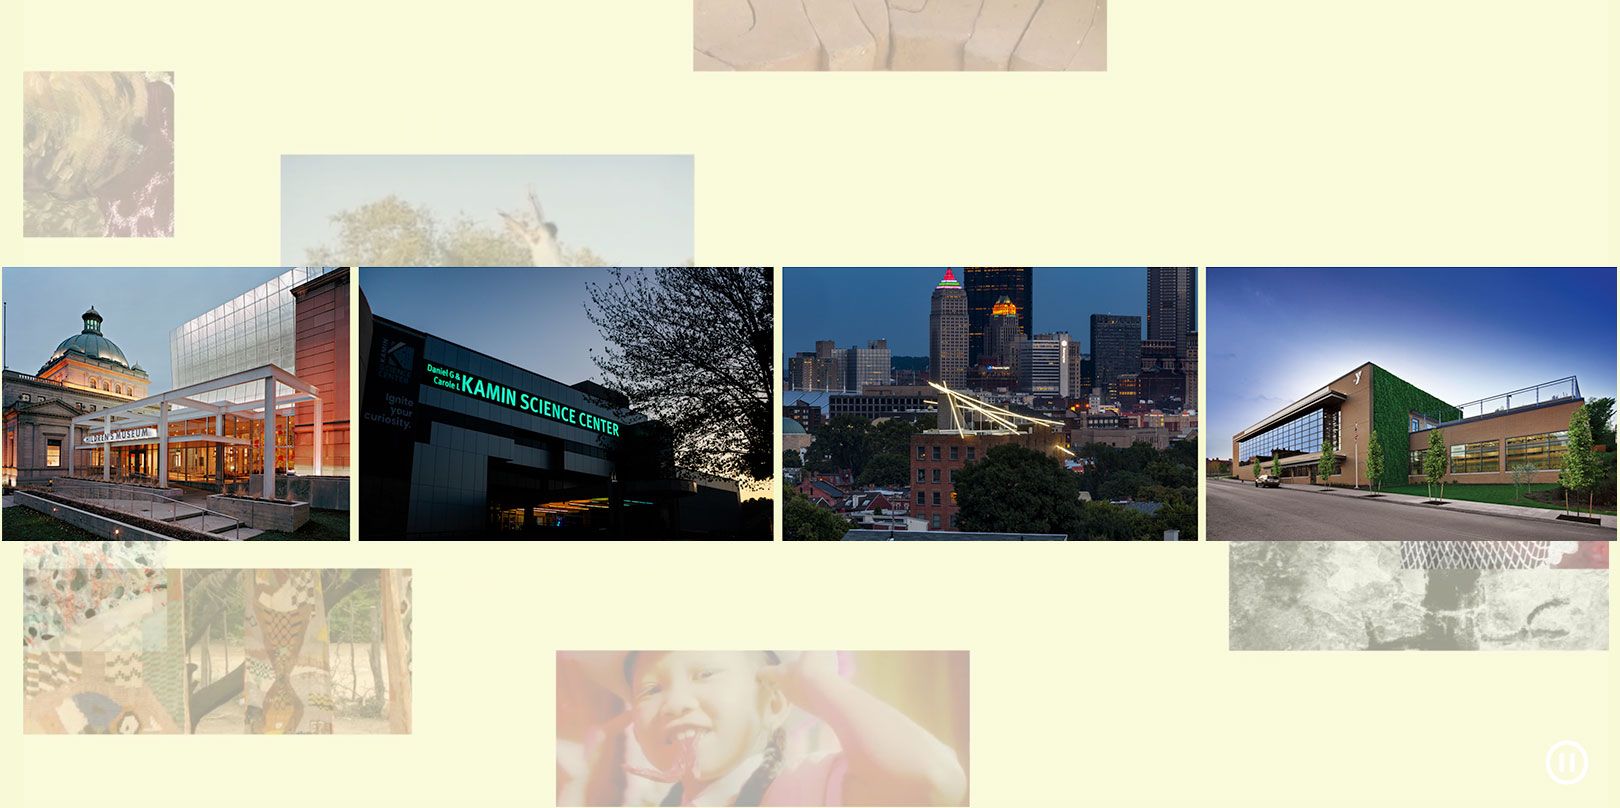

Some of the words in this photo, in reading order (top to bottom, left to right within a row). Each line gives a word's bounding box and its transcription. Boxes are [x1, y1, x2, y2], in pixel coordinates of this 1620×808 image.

[427, 363, 449, 378] Daniel
[449, 370, 455, 379] G
[455, 373, 461, 381] &
[433, 376, 455, 390] Carole
[456, 383, 461, 391] L
[386, 393, 414, 406] Ignite
[461, 374, 517, 407] KAMIN
[520, 393, 577, 424] SCIENCE
[579, 412, 620, 437] CENTER
[390, 406, 413, 418] your
[363, 411, 412, 430] curiosity.
[116, 428, 148, 440] MUSEUM
